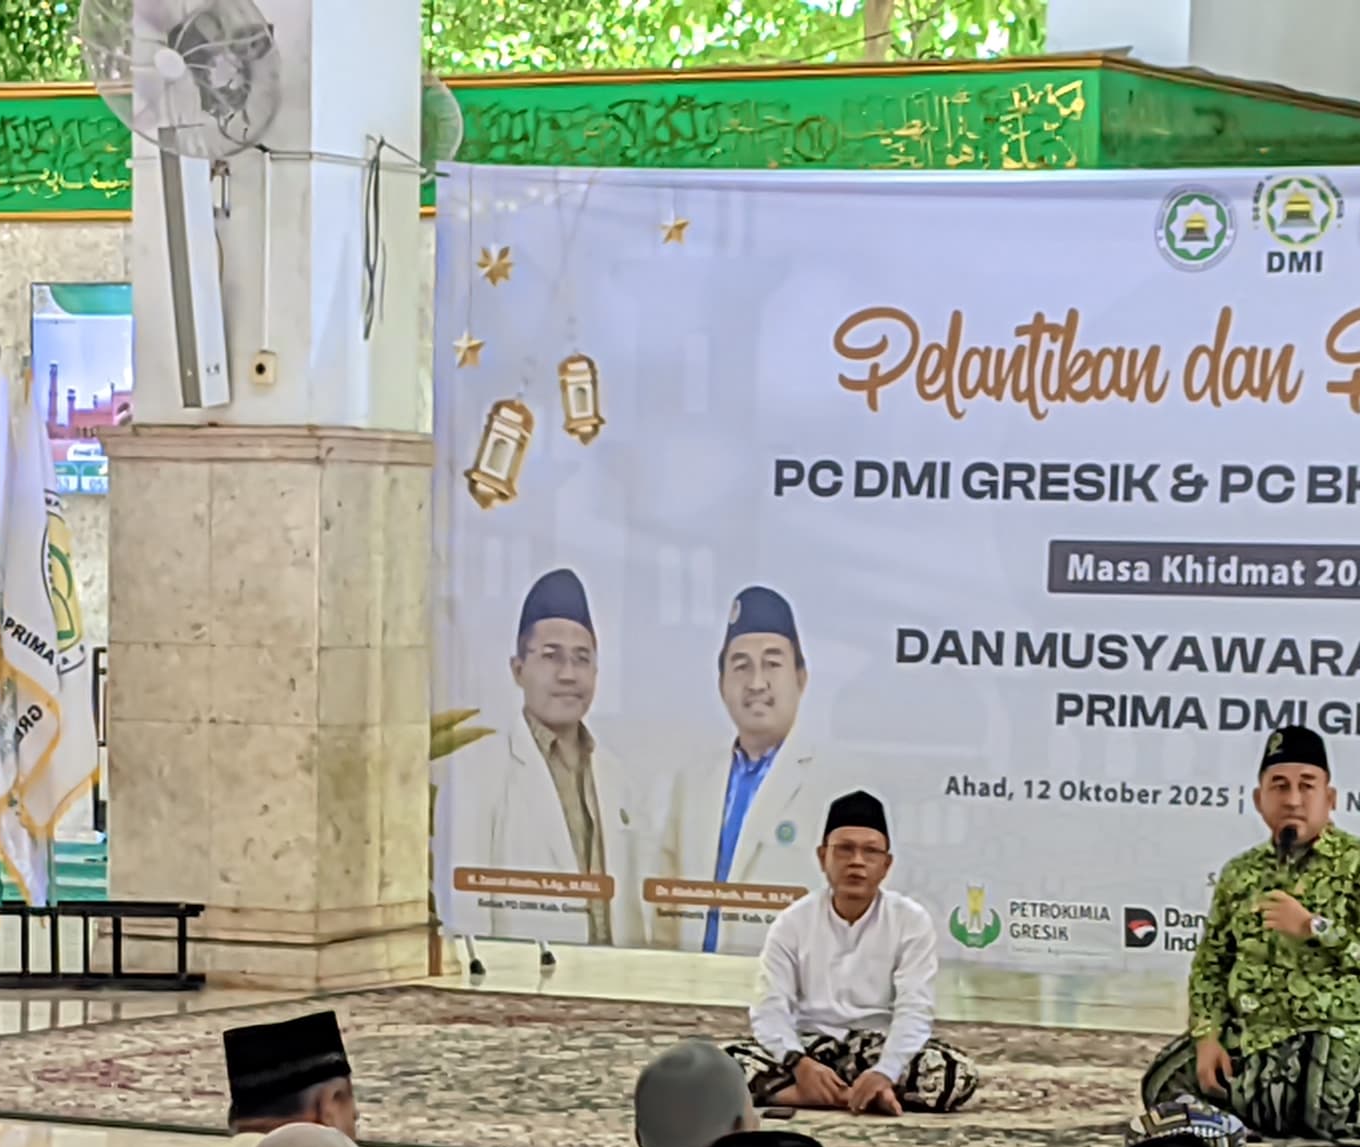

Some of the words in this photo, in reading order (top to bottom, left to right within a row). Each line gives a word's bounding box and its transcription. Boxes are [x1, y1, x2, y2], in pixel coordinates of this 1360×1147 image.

[1266, 250, 1323, 273] DMI
[833, 306, 1170, 421] Pelantikan
[1183, 305, 1304, 409] dan
[773, 458, 844, 498] PC
[853, 460, 951, 500] DMI
[961, 461, 1161, 503] GRESIK
[1170, 463, 1209, 503] &
[1219, 464, 1296, 504] PC
[1067, 553, 1150, 582] Masa
[1161, 555, 1305, 586] Khidmat
[3, 617, 55, 665] PRIMA
[895, 628, 1005, 667] DAN
[1055, 692, 1209, 731] PRIMA
[1218, 698, 1308, 731] DMI
[944, 775, 1014, 801] Ahad,
[1023, 779, 1051, 800] 12
[1059, 780, 1162, 805] Oktober
[1168, 784, 1230, 808] 2025
[1009, 901, 1111, 921] PETROKIMIA
[1009, 922, 1069, 941] GRESIK
